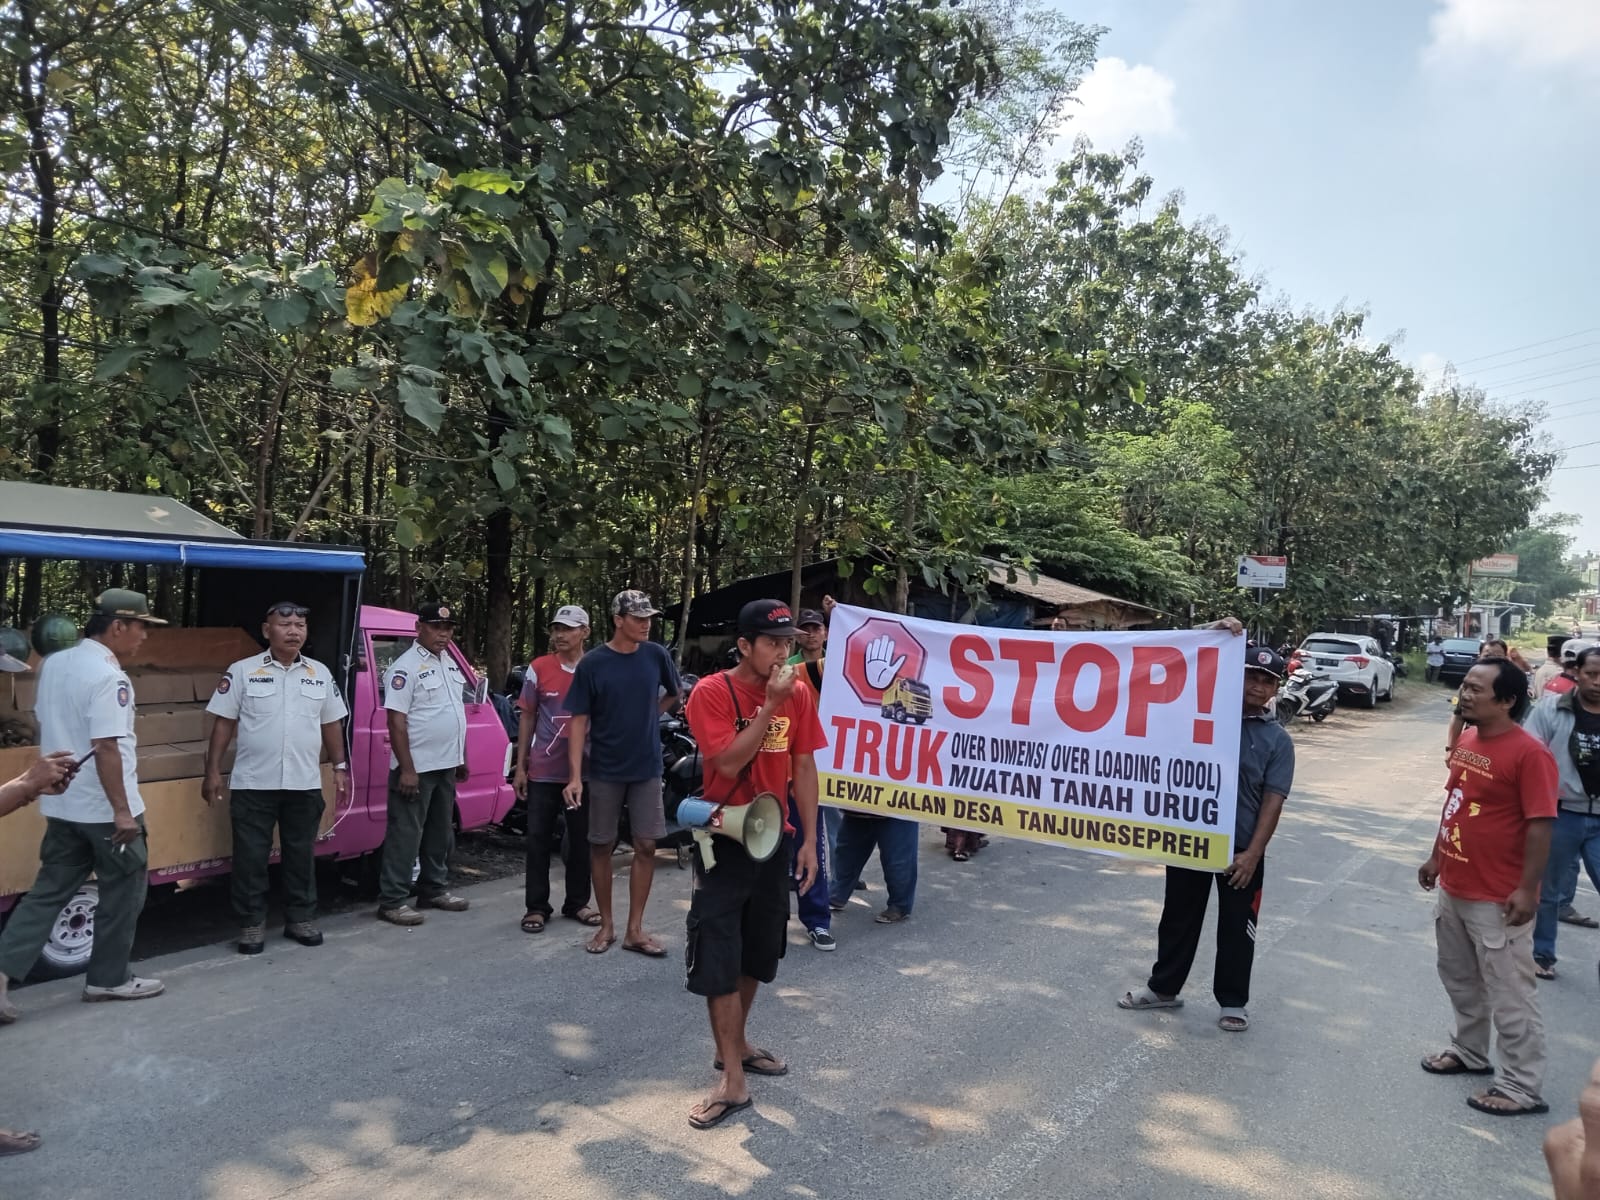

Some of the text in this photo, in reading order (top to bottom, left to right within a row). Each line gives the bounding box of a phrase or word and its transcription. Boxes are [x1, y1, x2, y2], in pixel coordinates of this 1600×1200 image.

[300, 678, 315, 686] POL
[944, 636, 1219, 744] STOP!
[831, 715, 947, 786] TRUK
[951, 733, 1221, 799] OVER DIMENSI OVER LOADING (ODOL)
[826, 778, 1210, 860] LEWAT JALAN DESA TANJUNGSEPREH
[949, 763, 1219, 826] MUATAN TANAH URUG
